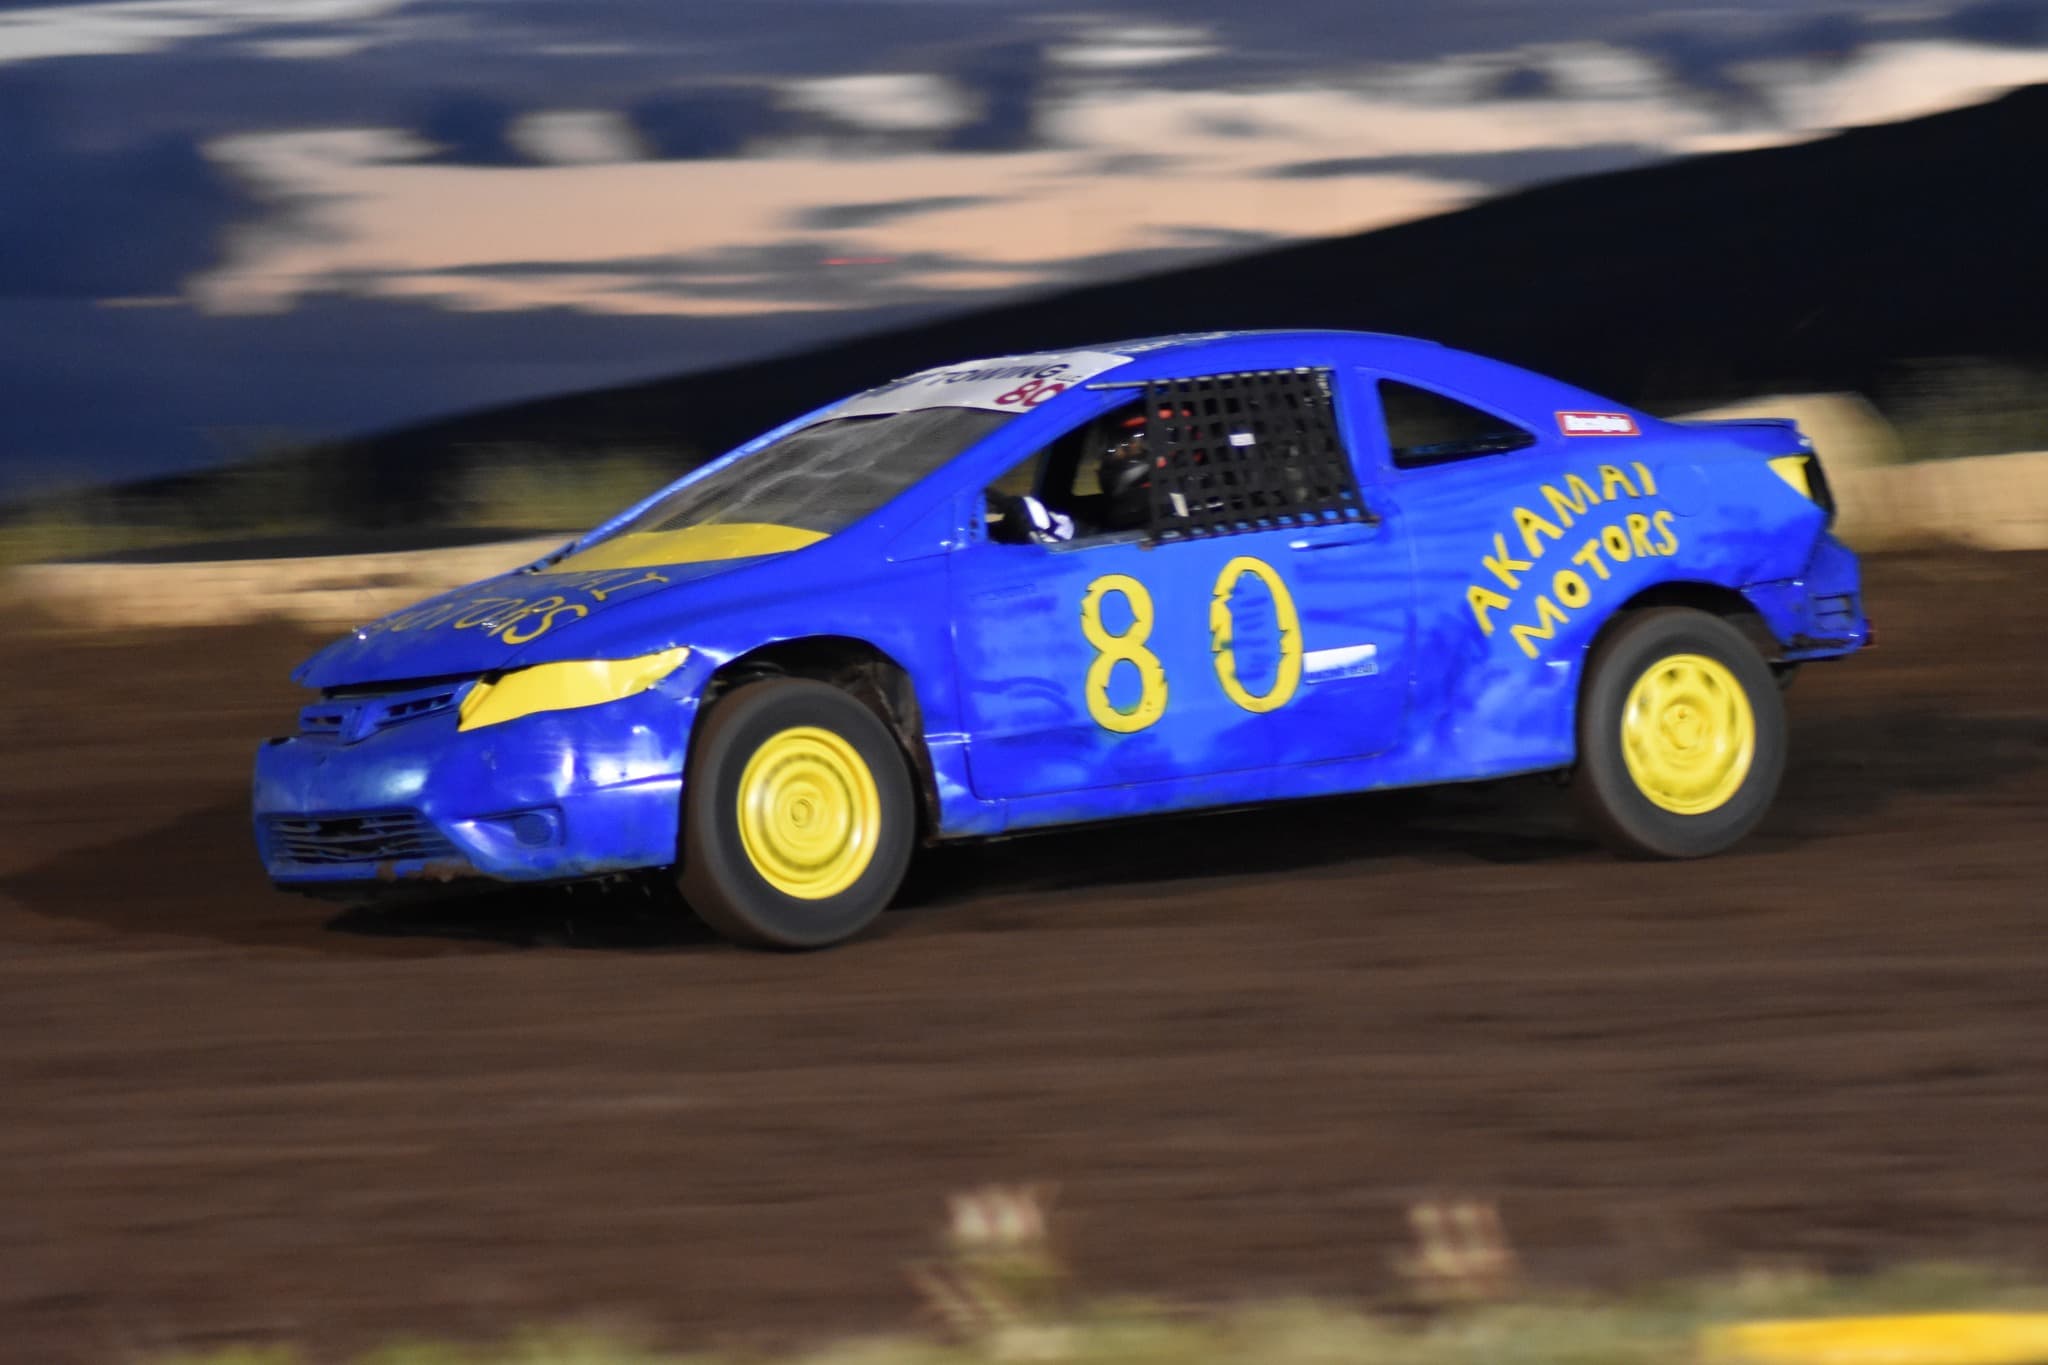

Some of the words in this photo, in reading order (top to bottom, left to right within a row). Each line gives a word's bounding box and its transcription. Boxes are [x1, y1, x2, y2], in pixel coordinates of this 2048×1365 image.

[926, 363, 1070, 387] TOWING
[995, 379, 1065, 407] 80
[1466, 462, 1658, 637] AKAMAI
[1509, 511, 1679, 660] MOTORS
[1081, 556, 1303, 733] 80
